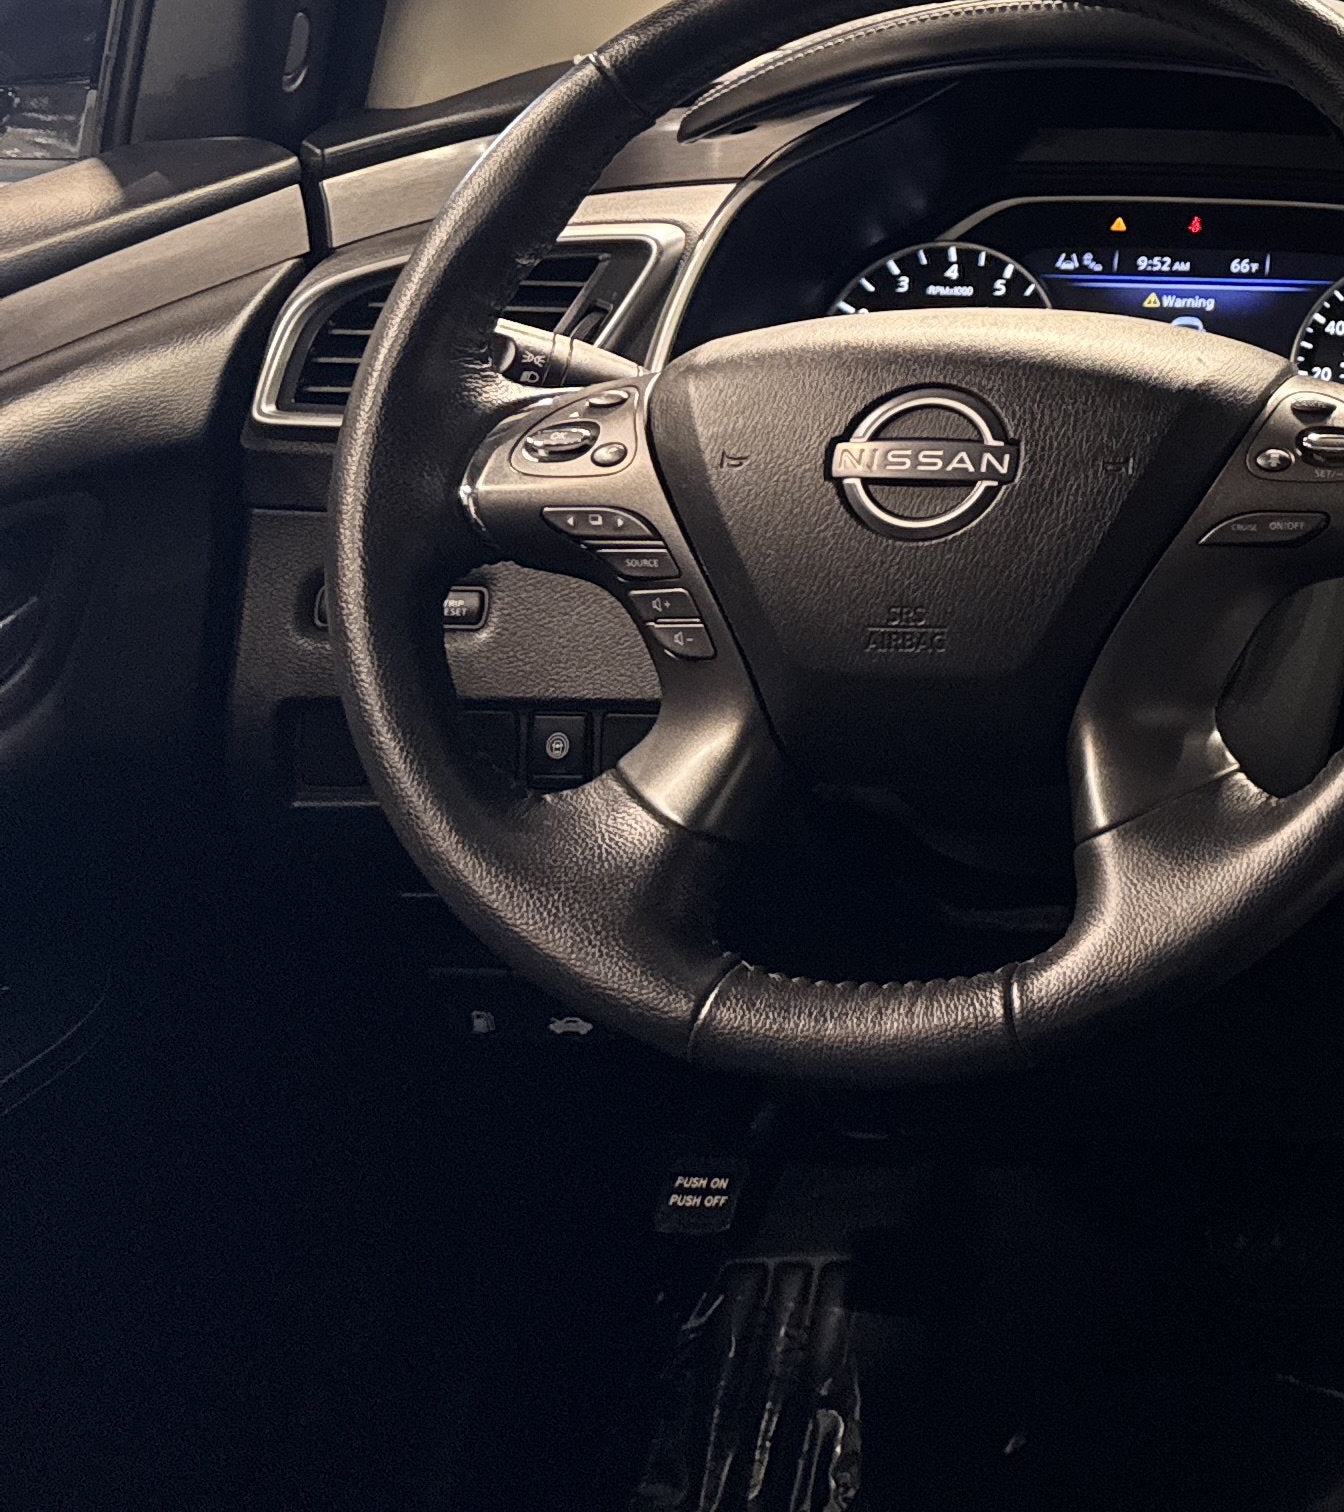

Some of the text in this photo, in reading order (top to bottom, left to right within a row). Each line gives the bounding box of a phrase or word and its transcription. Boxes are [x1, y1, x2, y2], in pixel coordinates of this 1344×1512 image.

[944, 263, 959, 280] 4
[1136, 256, 1191, 272] 9:52 AM
[895, 276, 910, 293] 3
[992, 279, 1007, 296] 5
[1161, 294, 1215, 312] Warning
[1311, 366, 1332, 382] 20
[837, 448, 1010, 474] NISSAN
[625, 557, 659, 568] SOURCE
[887, 607, 928, 626] SRS
[864, 632, 948, 653] AIRBAG
[674, 1175, 729, 1189] PUSH ON
[667, 1194, 729, 1207] PUSH OFF
